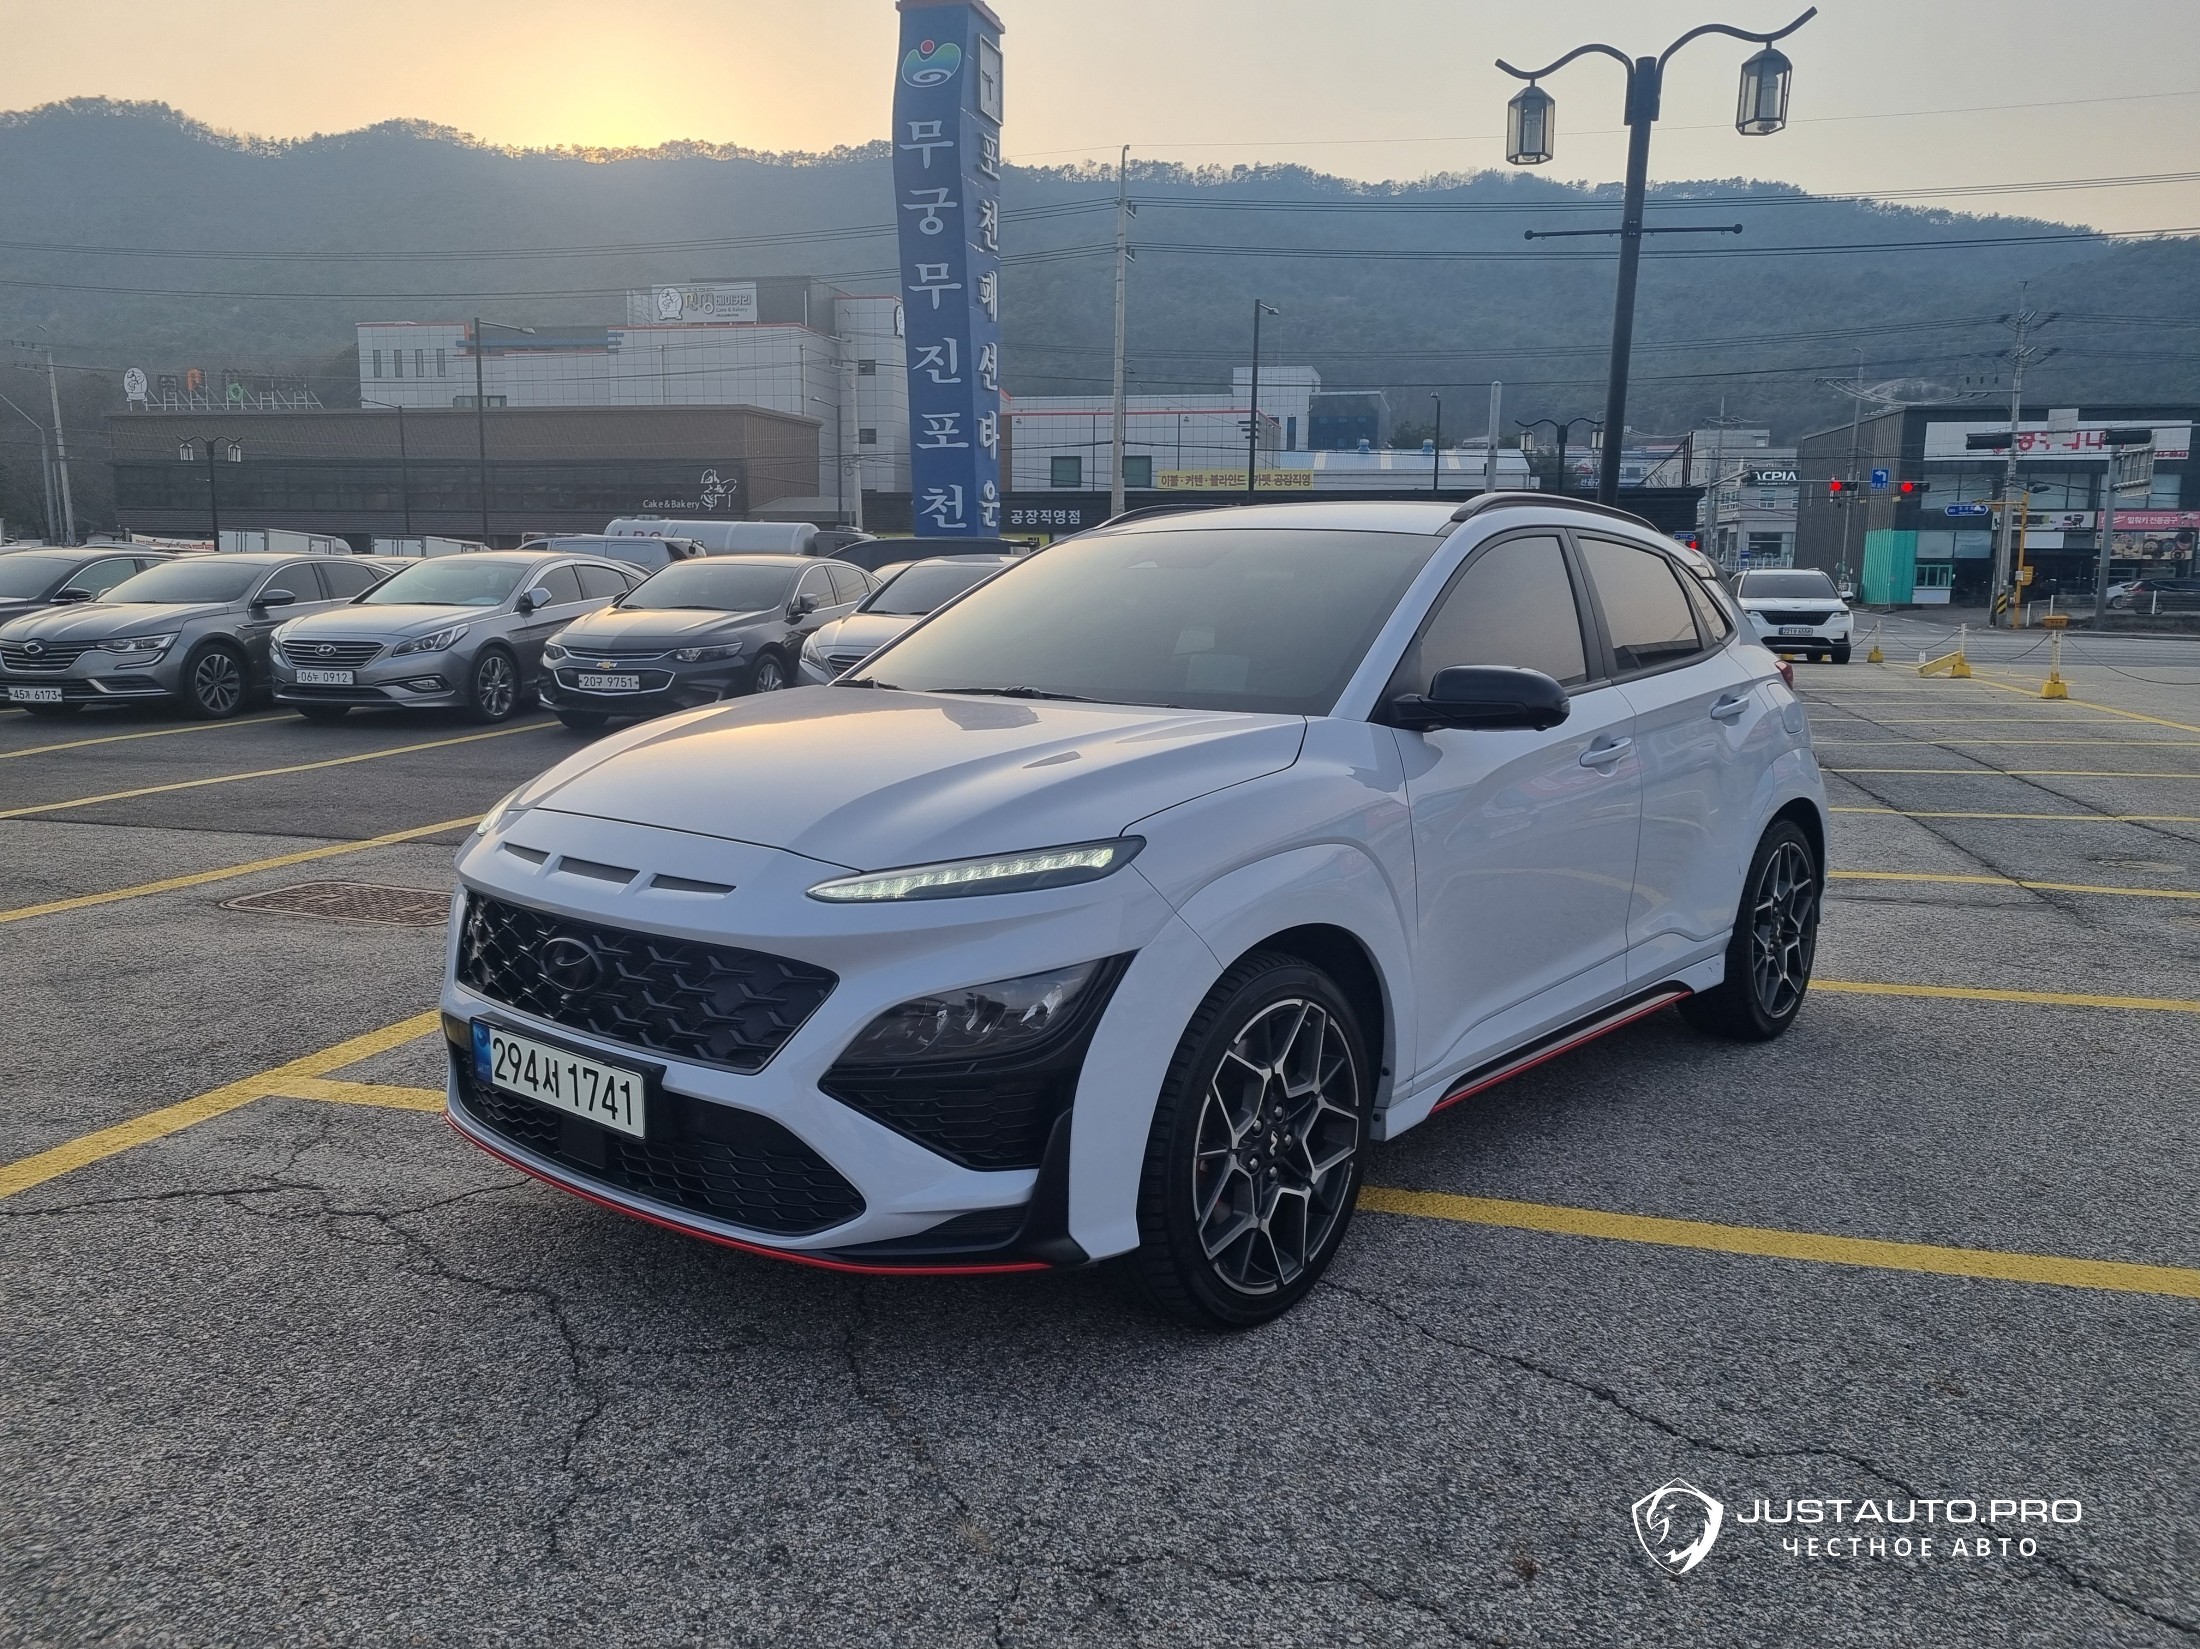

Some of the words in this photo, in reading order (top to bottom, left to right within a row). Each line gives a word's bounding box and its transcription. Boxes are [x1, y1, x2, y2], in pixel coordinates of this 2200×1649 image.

[899, 120, 962, 384] 무궁무진
[916, 412, 969, 528] 포천
[1010, 510, 1081, 525] 공장직영점
[323, 672, 348, 683] 0912
[583, 676, 603, 687] 20구
[607, 677, 632, 688] 9751
[34, 690, 57, 700] 6173
[493, 1037, 560, 1099] 294서
[567, 1063, 632, 1126] 1741
